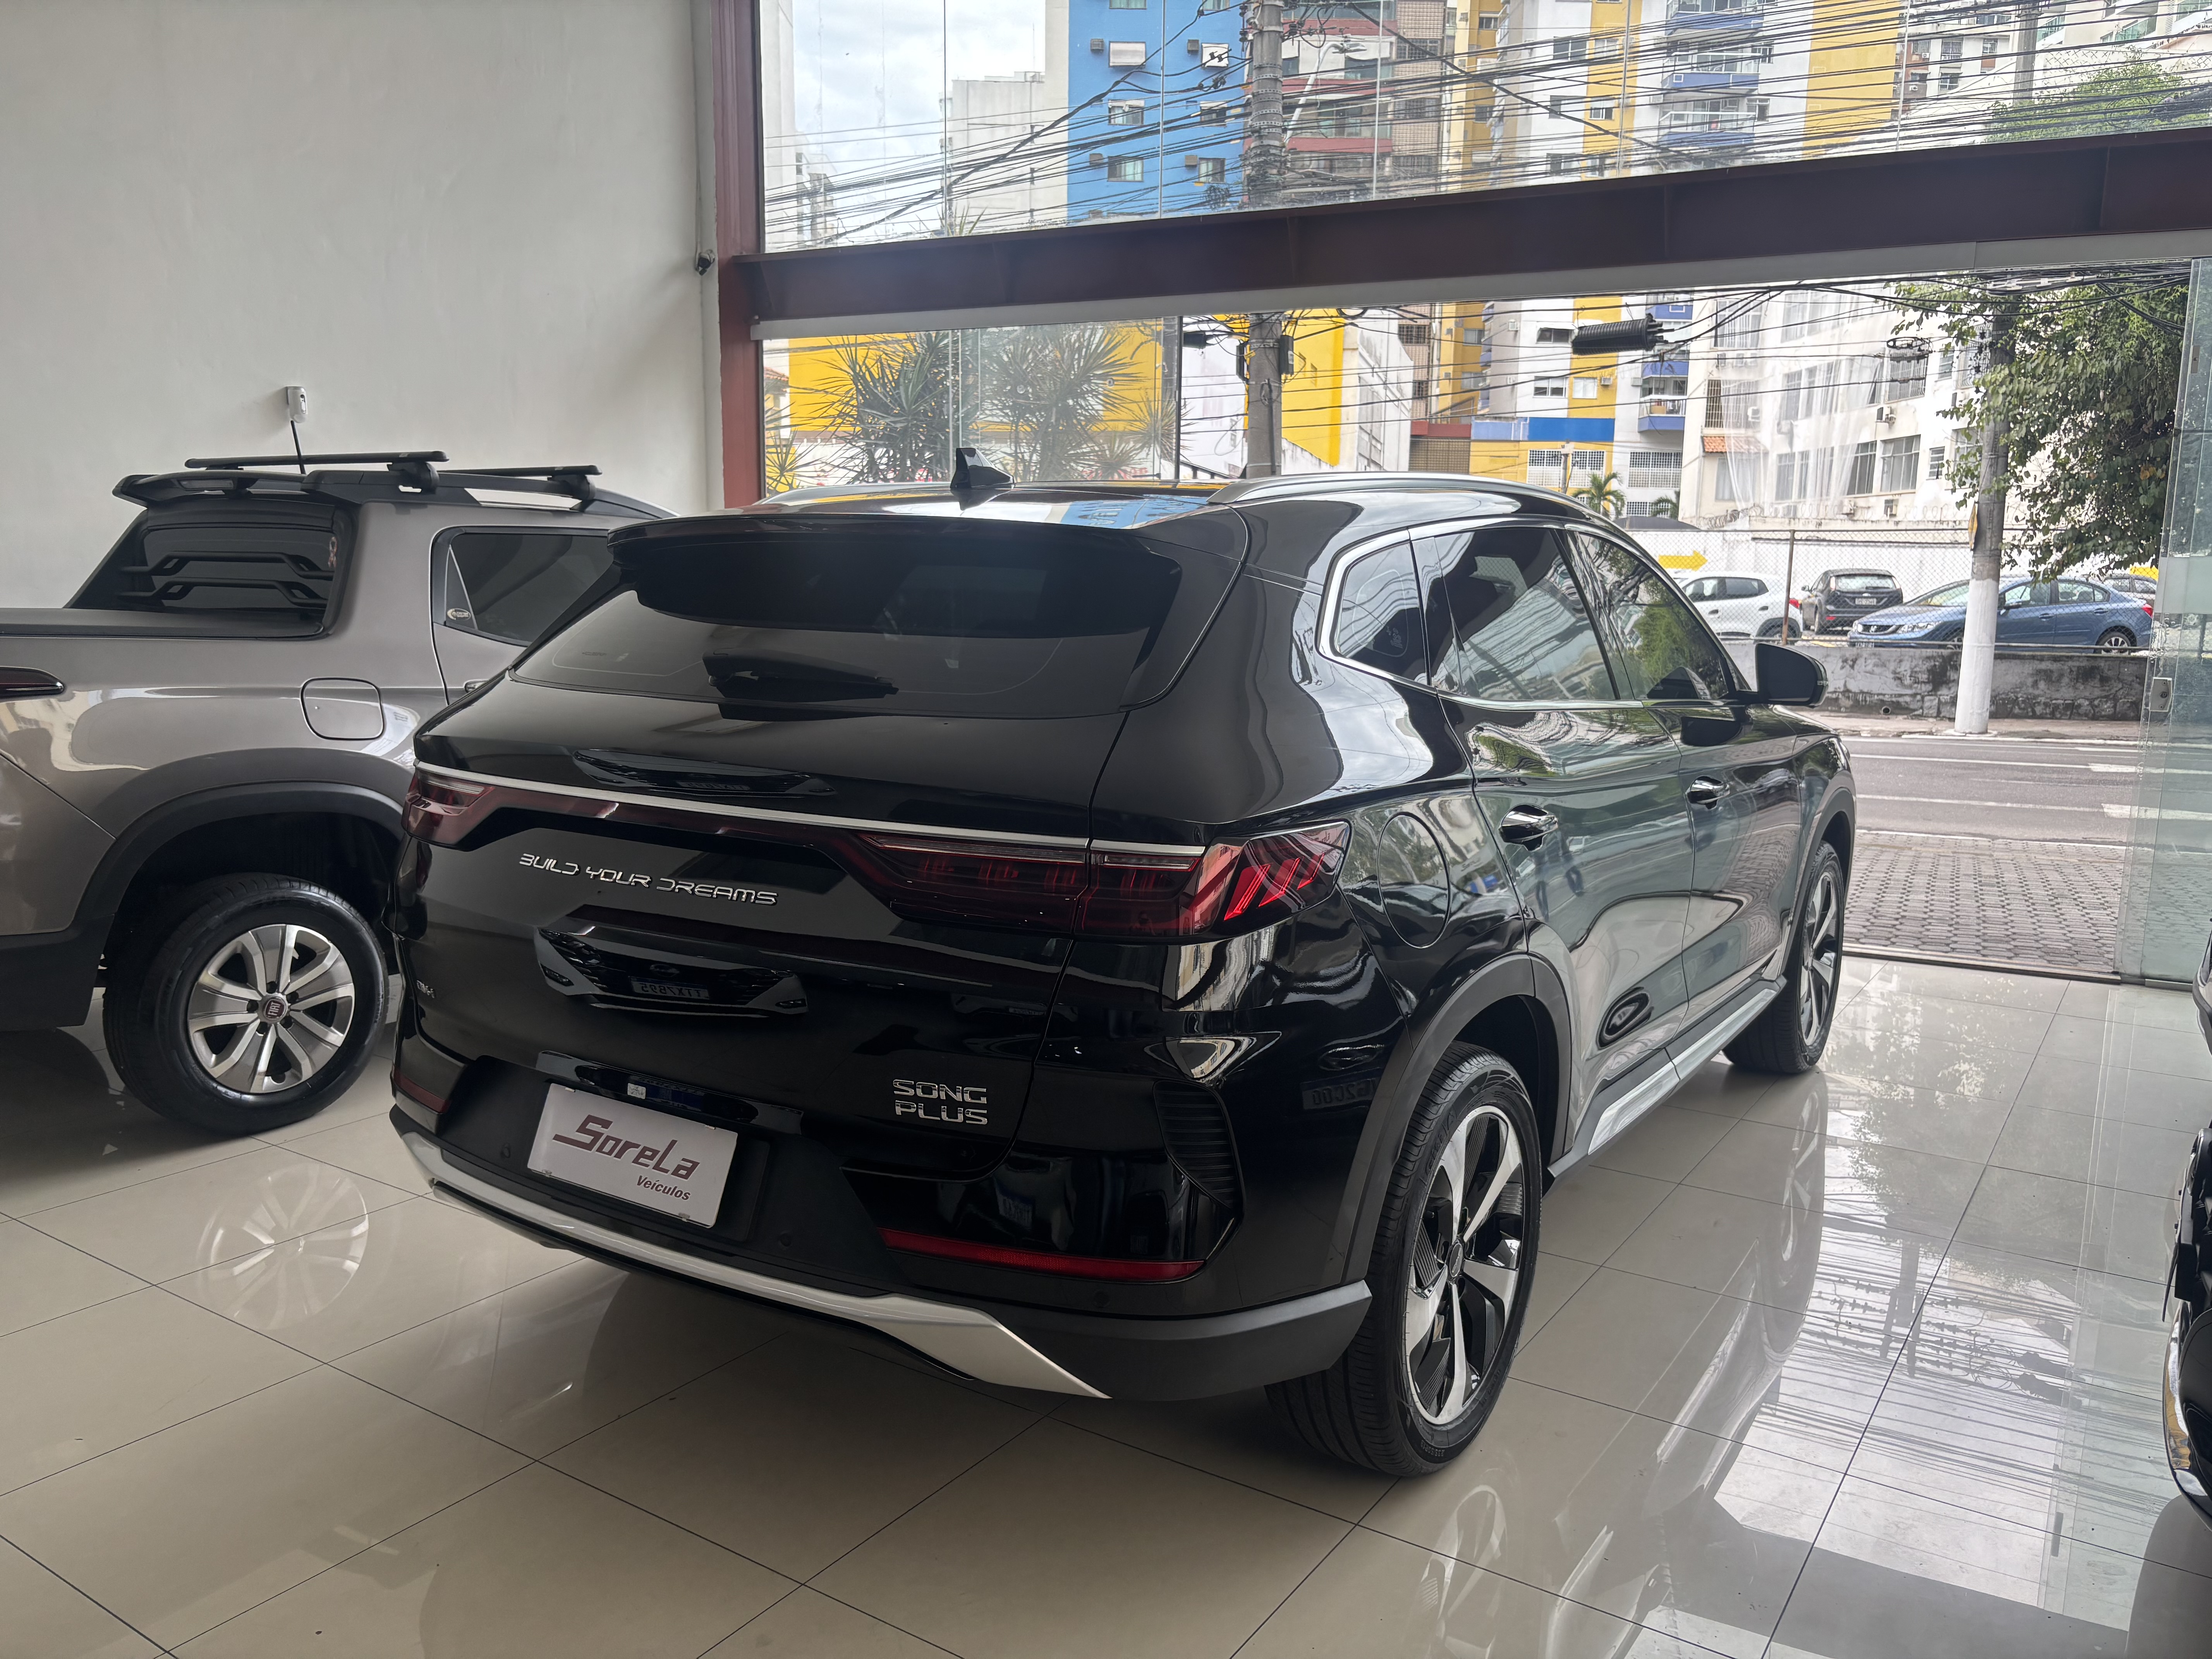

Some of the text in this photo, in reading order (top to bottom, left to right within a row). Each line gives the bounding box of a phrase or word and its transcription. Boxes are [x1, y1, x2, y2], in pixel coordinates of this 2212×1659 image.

[519, 853, 778, 905] BUILD YOUR DREAMS
[267, 1001, 281, 1016] FIAT
[893, 1079, 987, 1104] SONG
[895, 1100, 988, 1125] PLUS
[636, 1175, 691, 1201] Veículos
